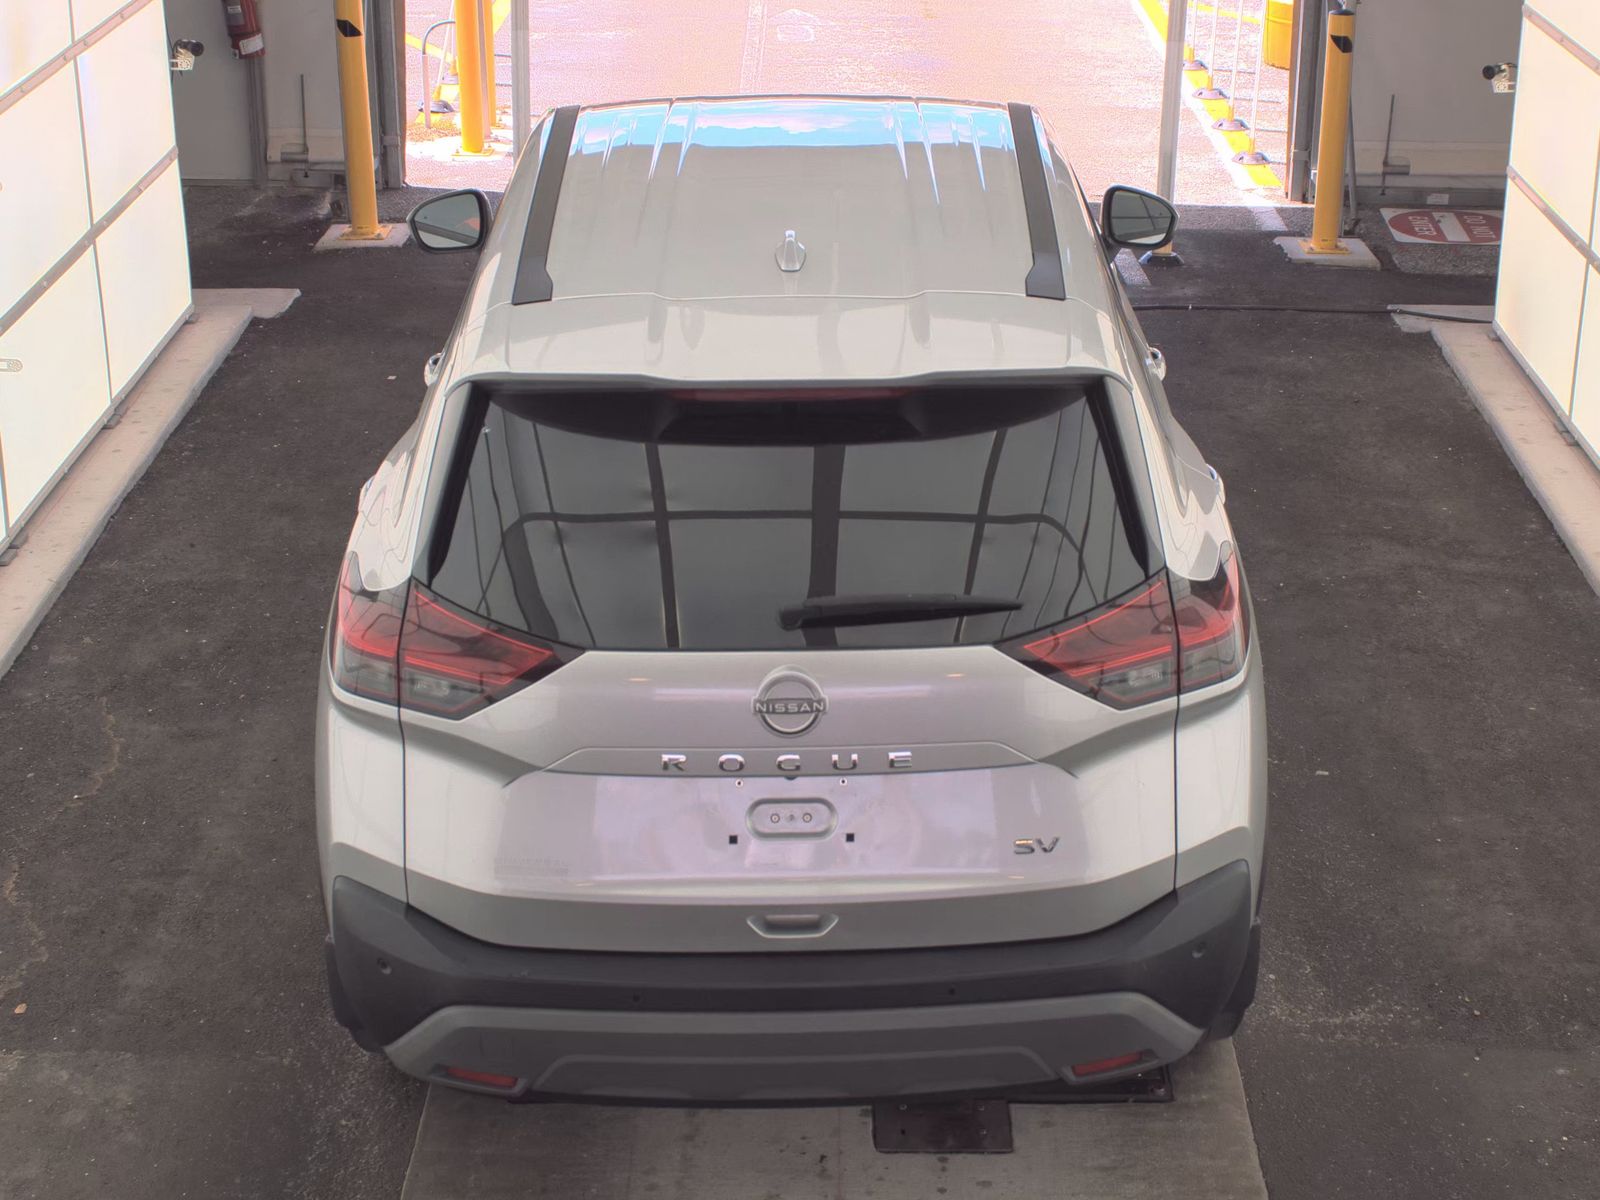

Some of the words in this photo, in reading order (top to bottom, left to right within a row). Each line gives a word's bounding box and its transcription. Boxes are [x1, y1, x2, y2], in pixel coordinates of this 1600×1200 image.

[1408, 216, 1437, 235] ENTER
[1463, 215, 1486, 224] DO
[1470, 225, 1496, 238] NOT
[756, 702, 824, 713] NISSAN
[661, 751, 913, 772] ROGUE
[1013, 837, 1060, 855] SV
